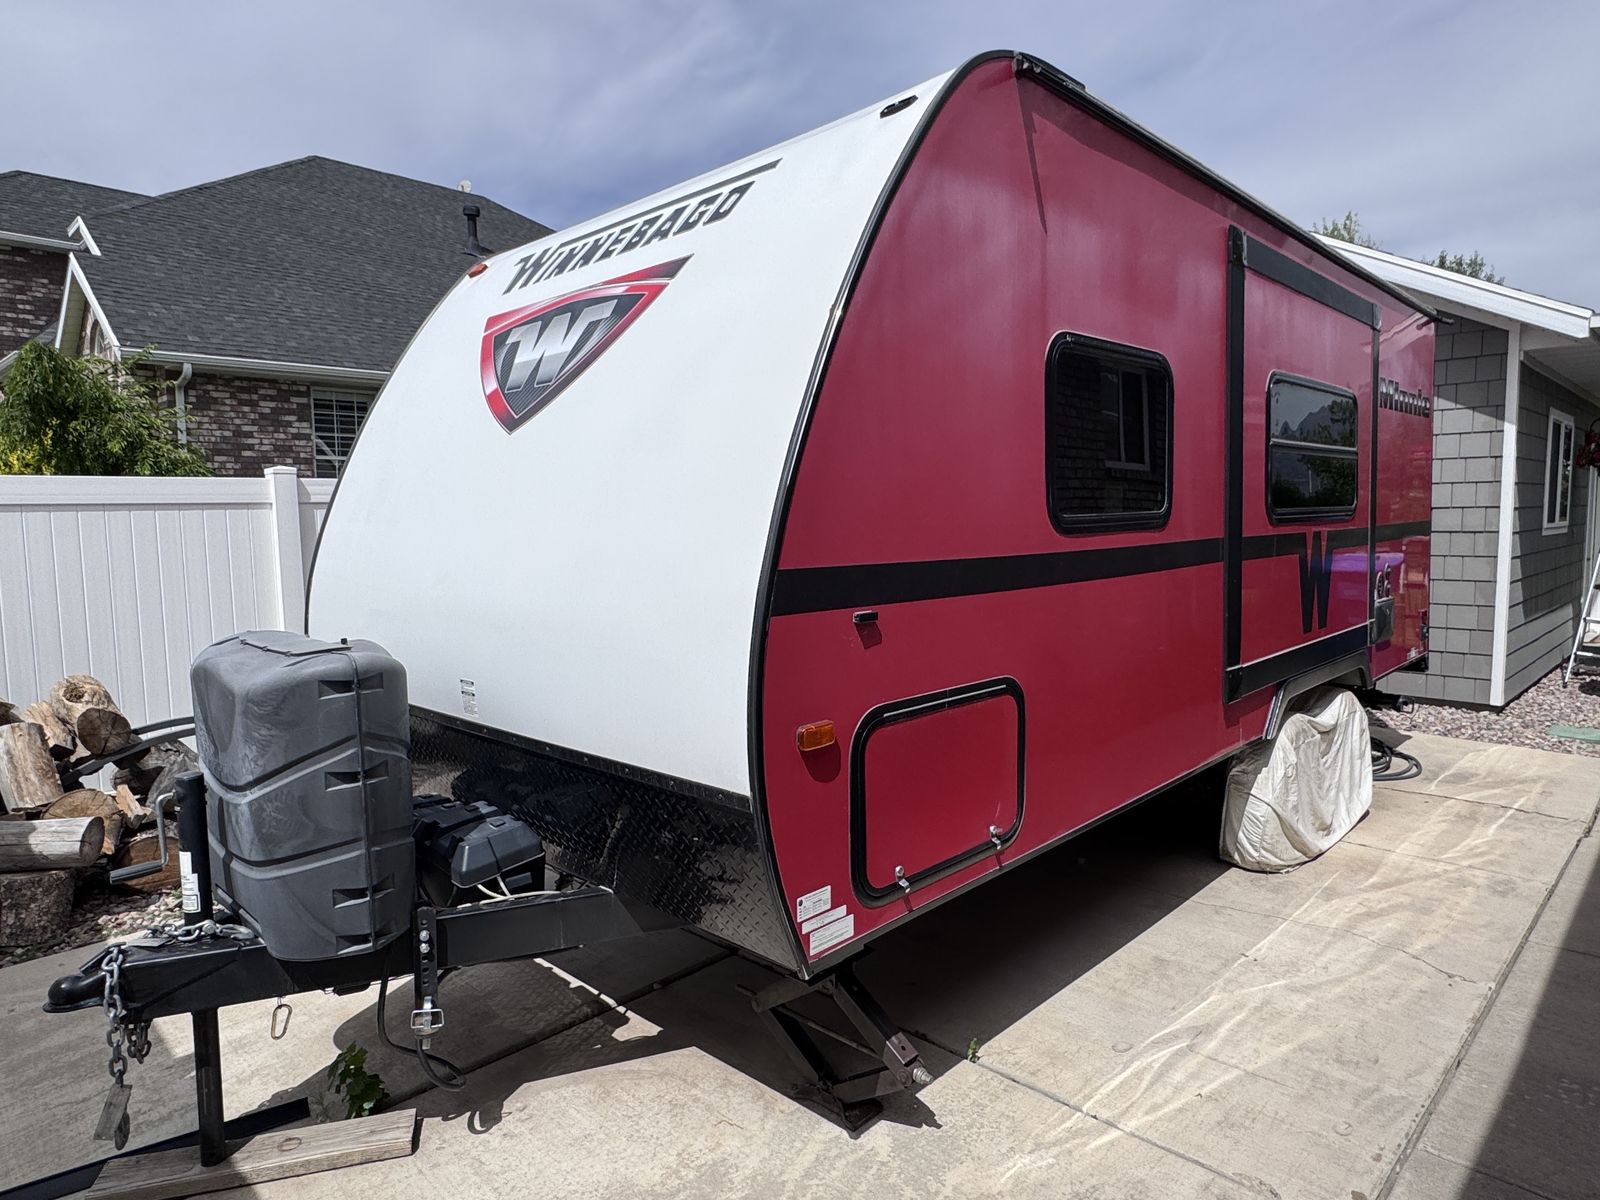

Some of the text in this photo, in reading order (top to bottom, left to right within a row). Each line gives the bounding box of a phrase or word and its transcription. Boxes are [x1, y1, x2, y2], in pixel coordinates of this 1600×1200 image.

[502, 180, 756, 295] WINNEBAGO
[505, 299, 617, 393] W
[1379, 376, 1431, 418] Minnie
